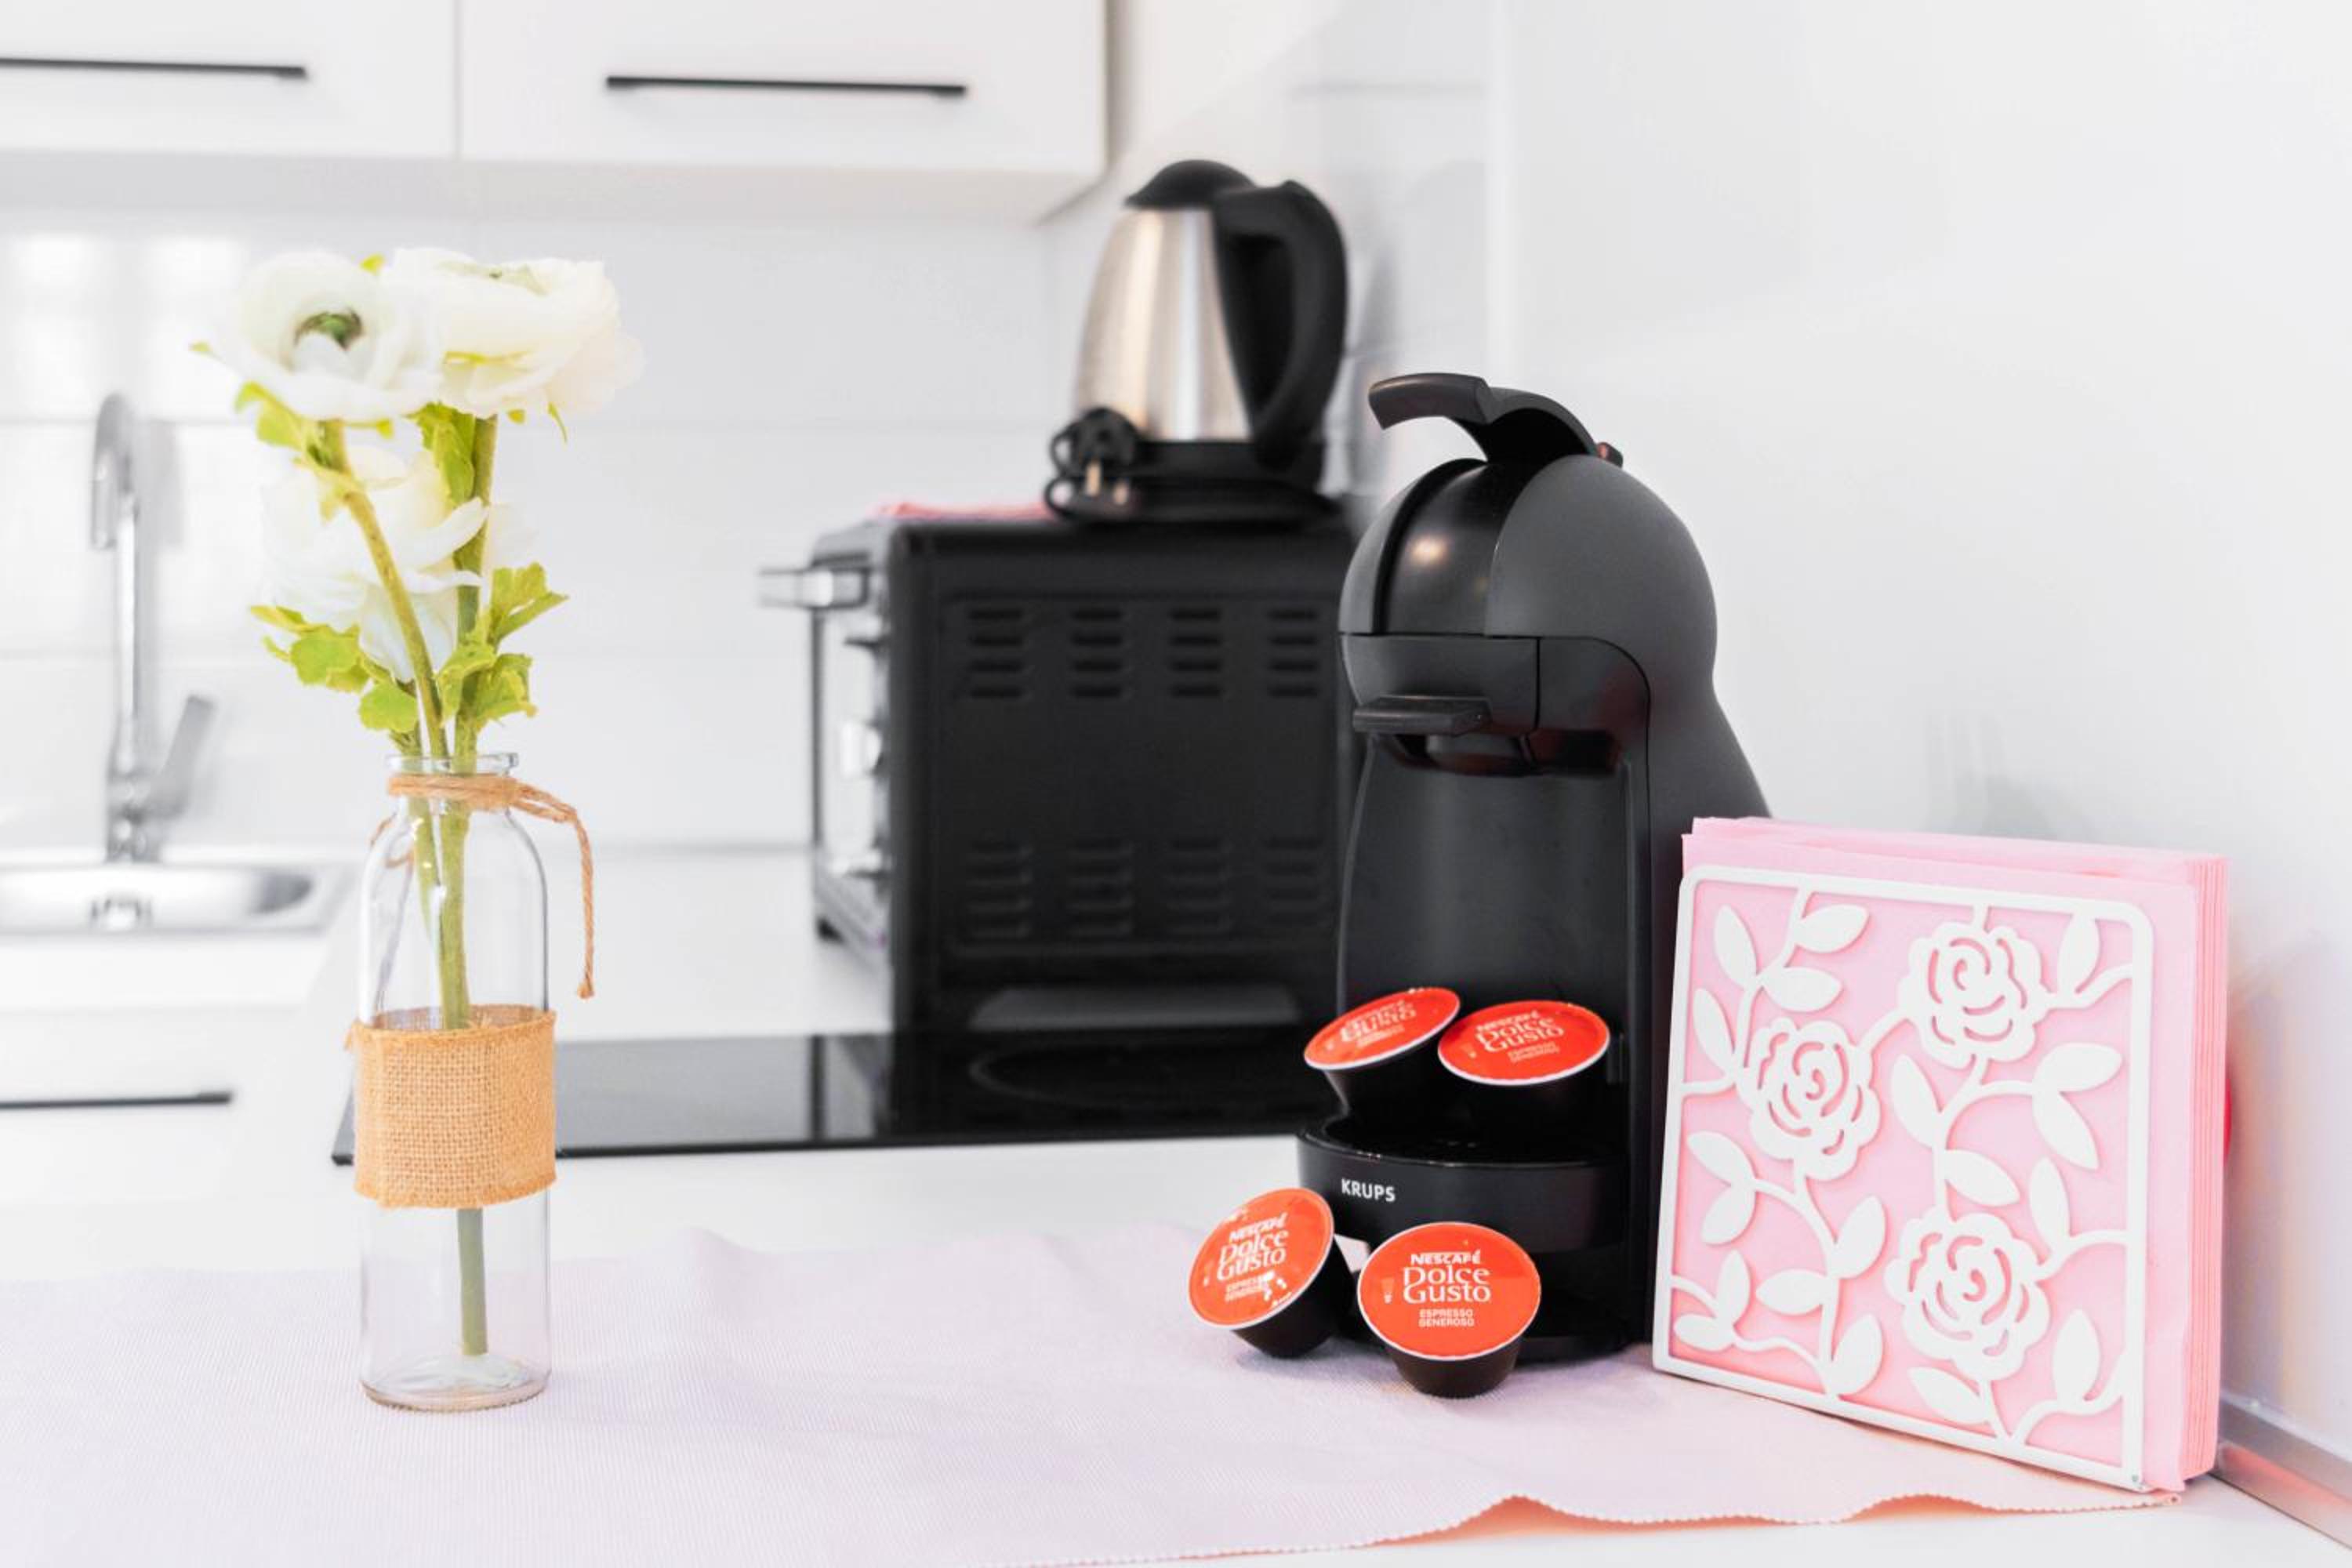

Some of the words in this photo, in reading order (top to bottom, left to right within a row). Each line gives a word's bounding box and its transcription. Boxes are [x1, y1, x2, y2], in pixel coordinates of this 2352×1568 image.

[1341, 1178, 1396, 1202] KRUPS
[1216, 1247, 1287, 1282] Gusto
[1410, 1249, 1481, 1265] NESCAFÉ
[1403, 1264, 1490, 1286] Dolce
[1403, 1283, 1491, 1305] Gusto
[1418, 1317, 1475, 1327] GENEROSO
[1419, 1308, 1473, 1319] ESPRESSO
